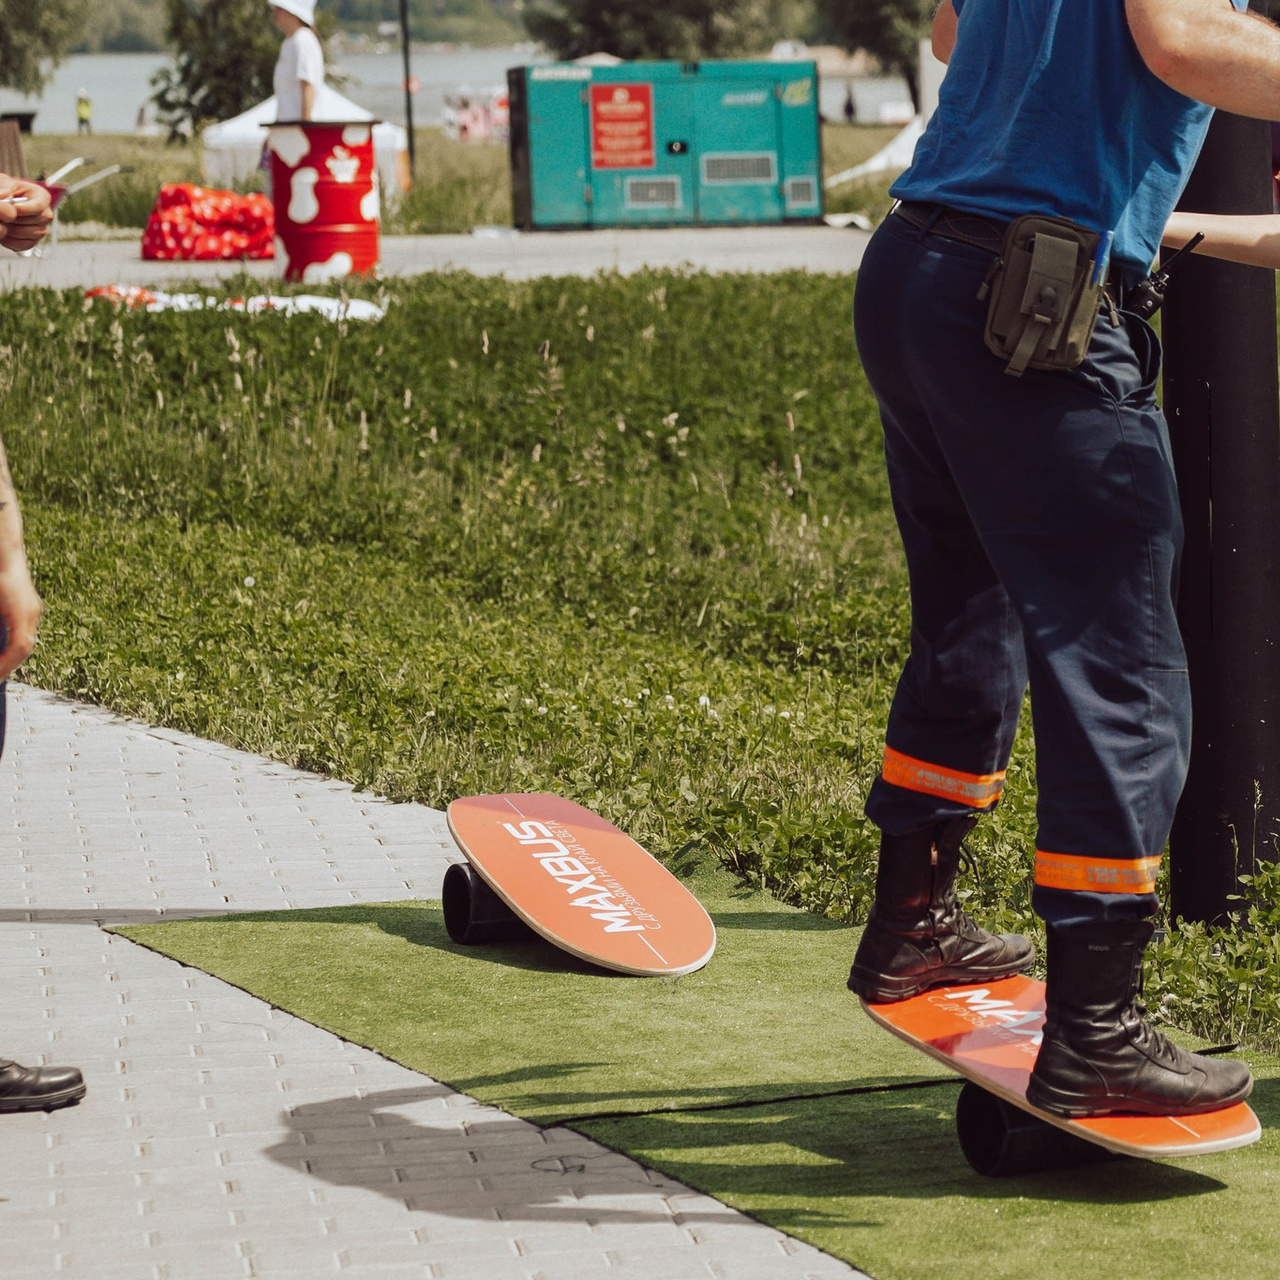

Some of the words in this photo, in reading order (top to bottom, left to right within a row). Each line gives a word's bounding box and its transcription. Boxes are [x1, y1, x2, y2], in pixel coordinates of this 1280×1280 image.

[544, 819, 577, 844] СВЕТА
[502, 820, 645, 933] MAXBUS
[591, 865, 612, 878] НА
[944, 988, 1047, 1046] MAX
